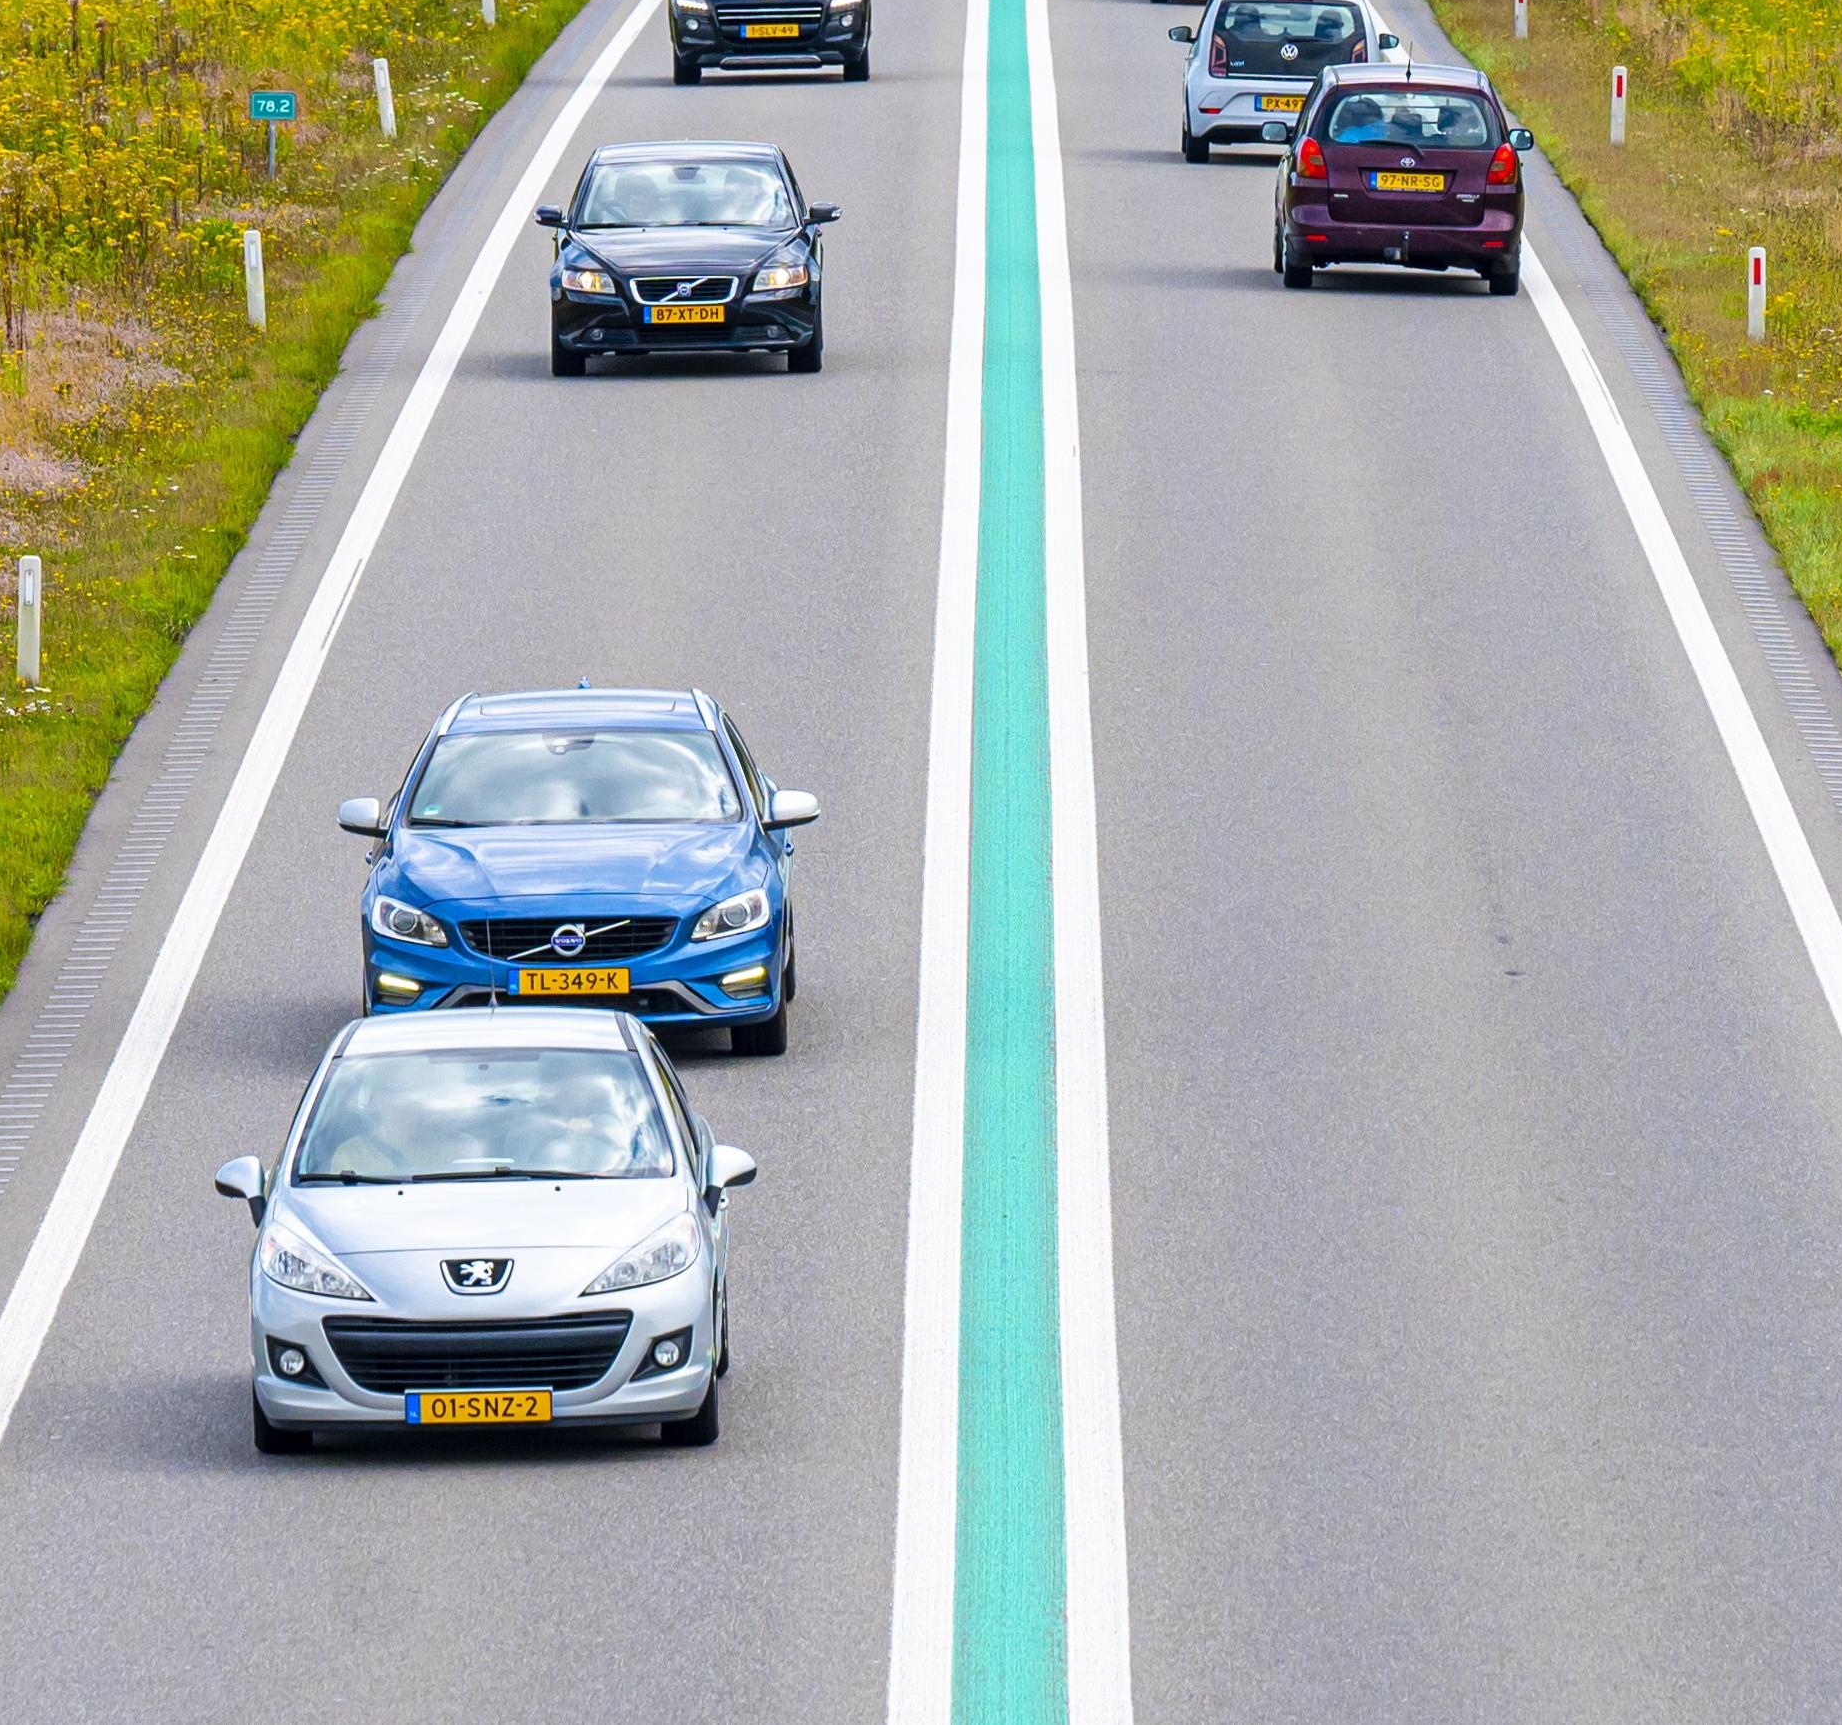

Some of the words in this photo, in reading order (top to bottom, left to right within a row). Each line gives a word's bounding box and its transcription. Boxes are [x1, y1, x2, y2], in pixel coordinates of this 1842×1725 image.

[1381, 175, 1440, 187] 97-NR-SG
[656, 308, 719, 321] 87-XT-DH
[526, 972, 619, 991] TL-349-K
[431, 1396, 538, 1418] 01-SNZ-2
